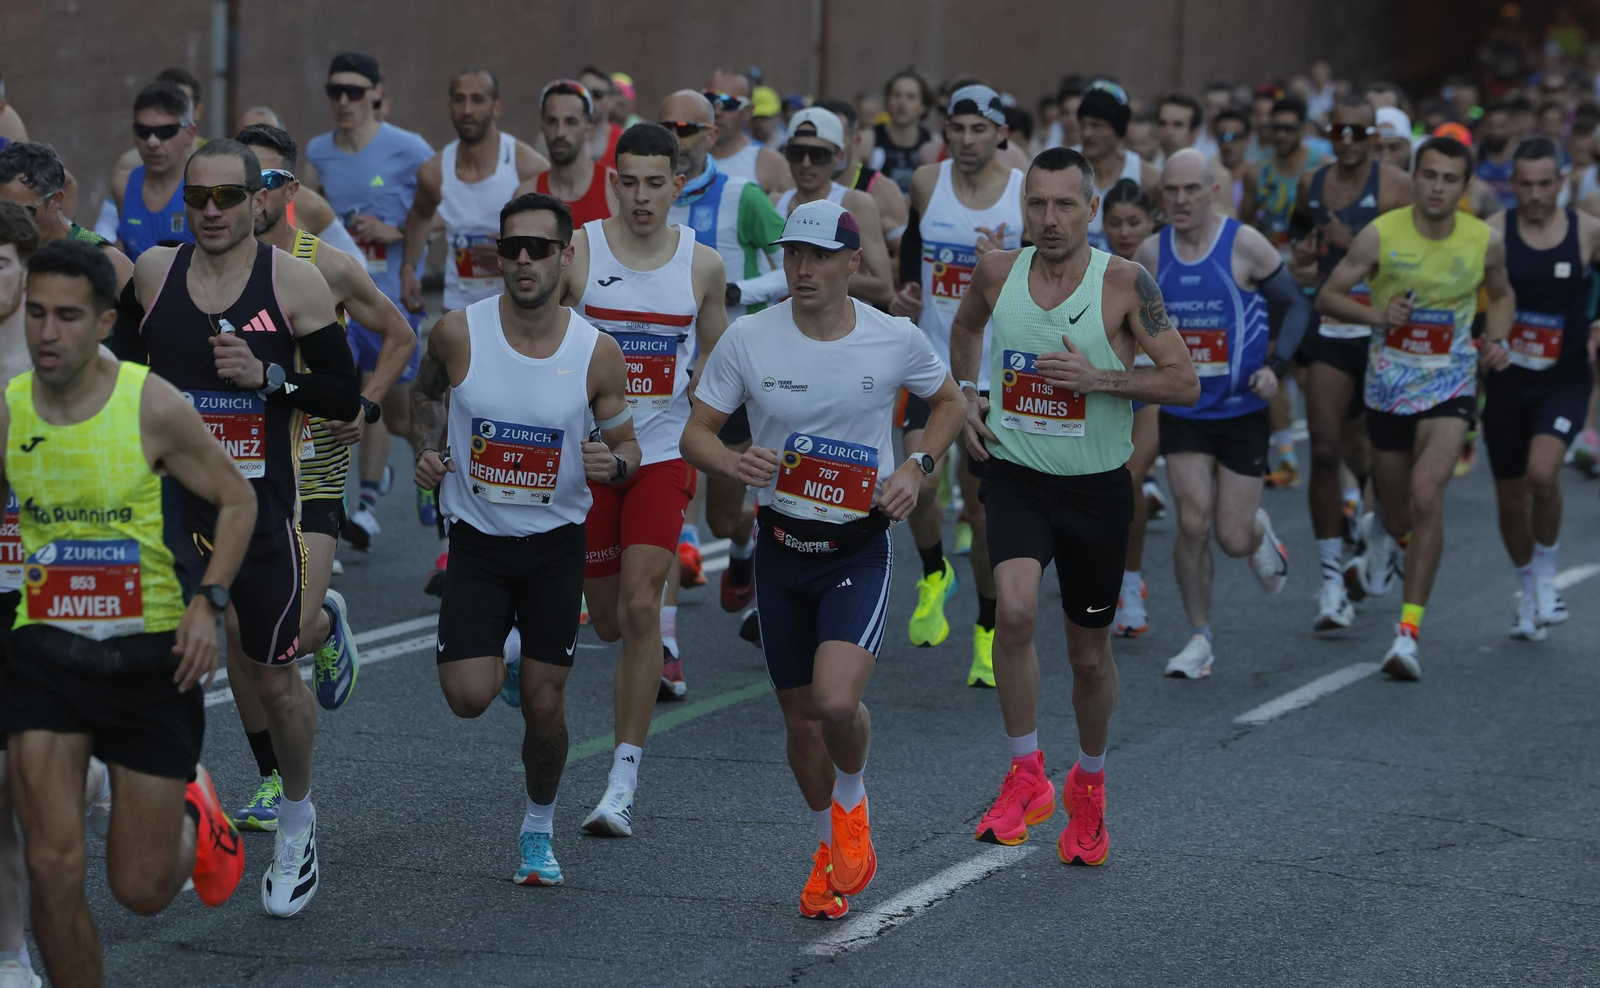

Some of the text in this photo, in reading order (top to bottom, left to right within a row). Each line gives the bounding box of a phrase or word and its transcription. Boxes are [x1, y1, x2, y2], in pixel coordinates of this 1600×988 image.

[625, 321, 651, 330] SPIKES
[622, 340, 668, 351] ZURICH
[1030, 382, 1054, 395] 1135
[200, 397, 253, 409] ZURICH
[1015, 396, 1068, 417] JAMES
[501, 428, 552, 443] ZURICH
[502, 451, 524, 463] 917
[818, 443, 869, 461] ZURICH
[470, 460, 557, 487] HERNANDEZ
[818, 467, 840, 481] 787
[803, 479, 845, 504] NICO
[53, 506, 132, 525] Running
[63, 546, 126, 561] ZURICH
[585, 545, 621, 560] SPIKES
[46, 595, 122, 618] JAVIER
